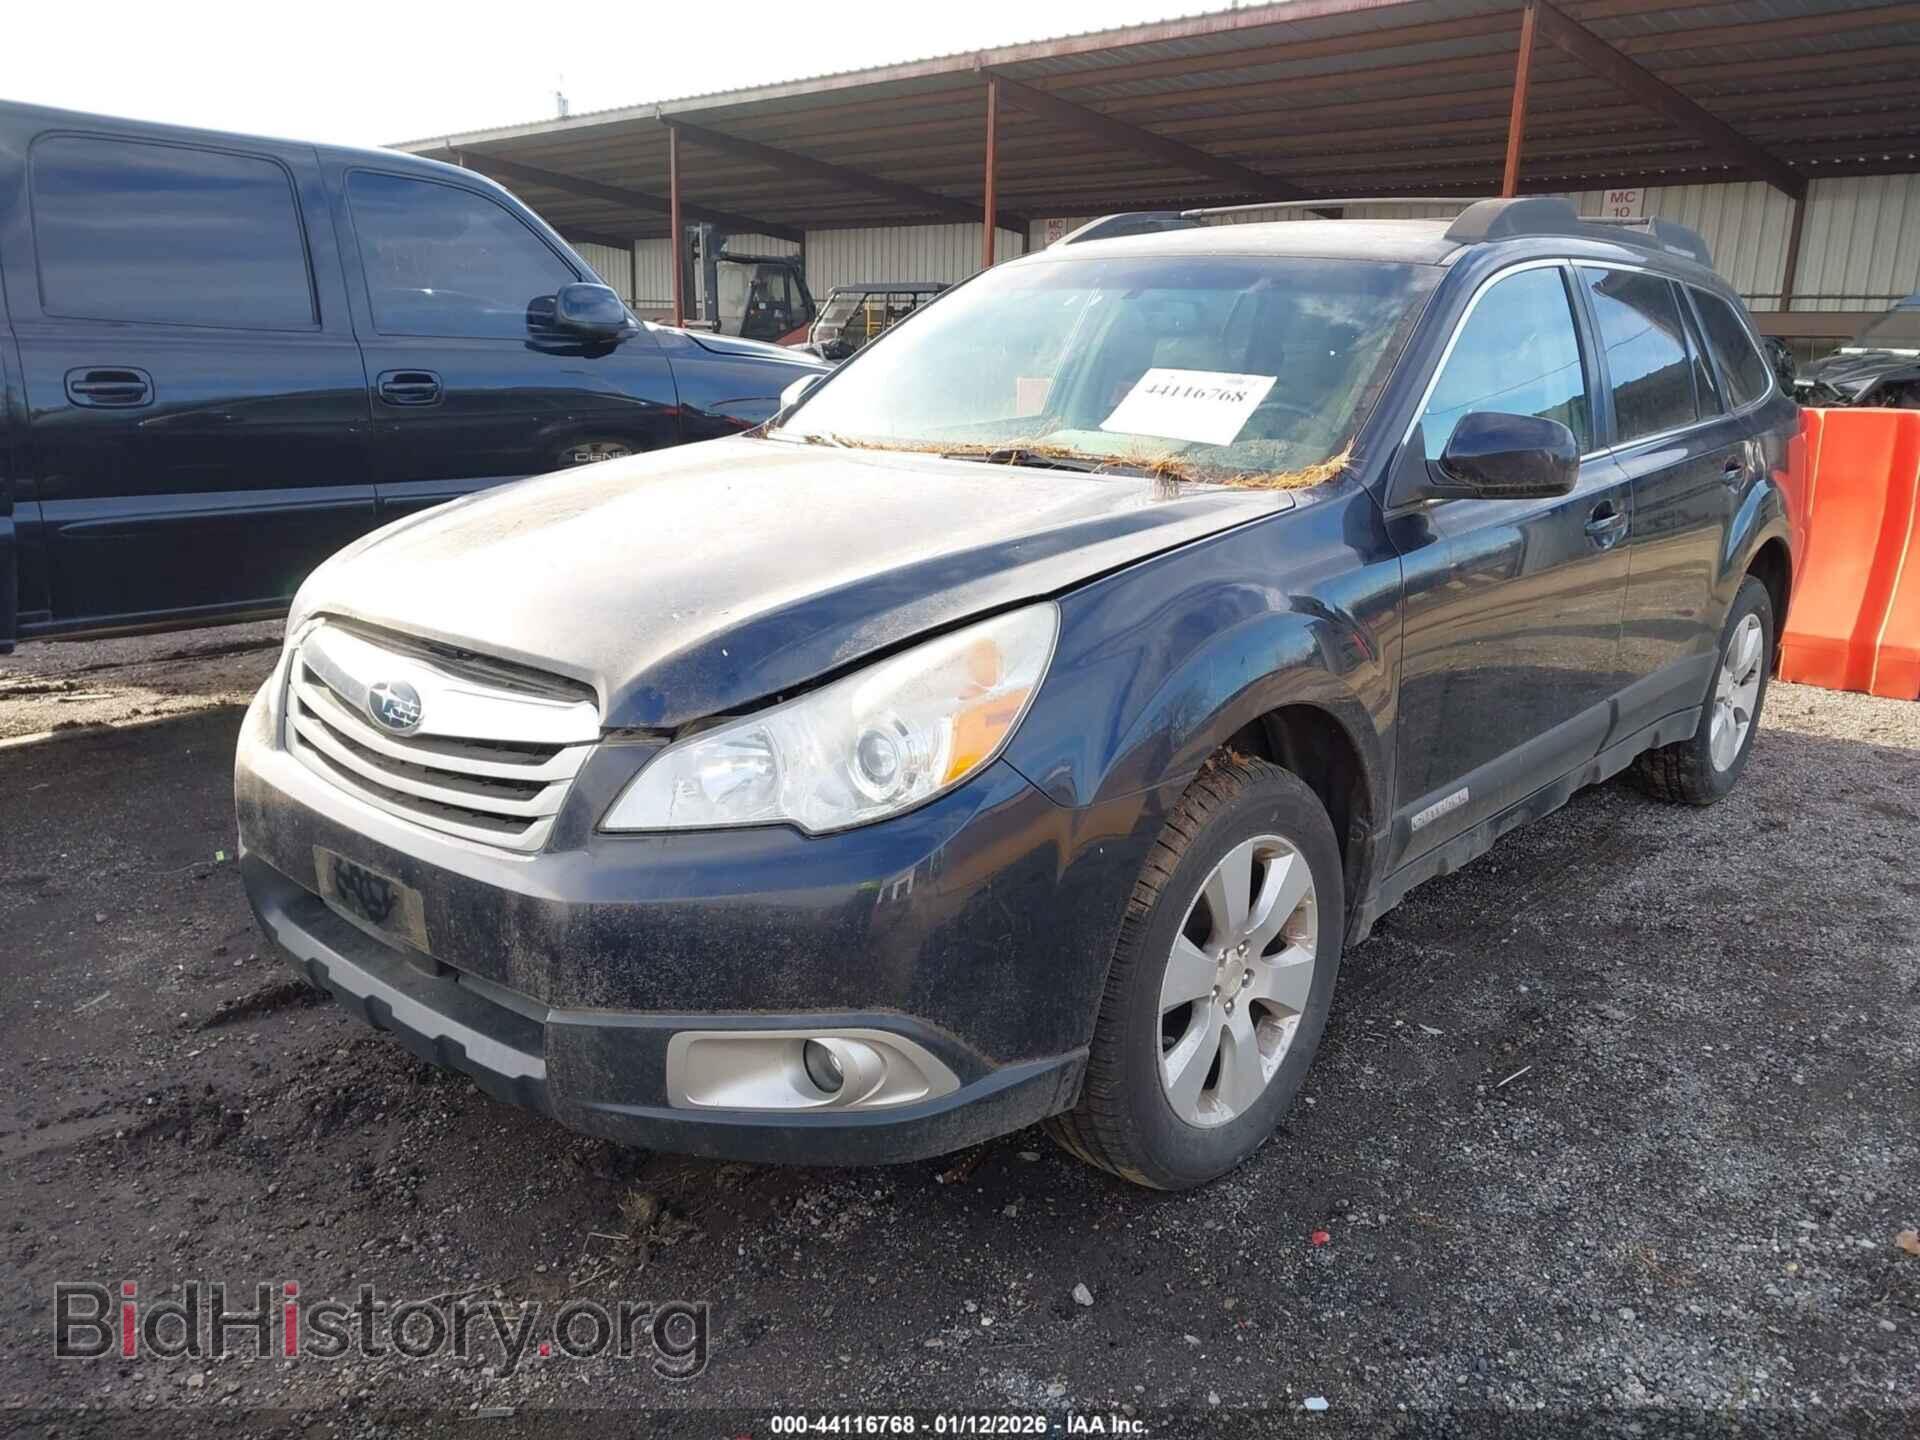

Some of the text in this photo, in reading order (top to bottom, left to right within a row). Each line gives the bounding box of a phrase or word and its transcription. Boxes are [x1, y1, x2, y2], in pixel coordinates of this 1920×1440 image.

[1610, 191, 1636, 203] MC
[1614, 206, 1631, 218] 10
[1145, 383, 1247, 402] 44116768
